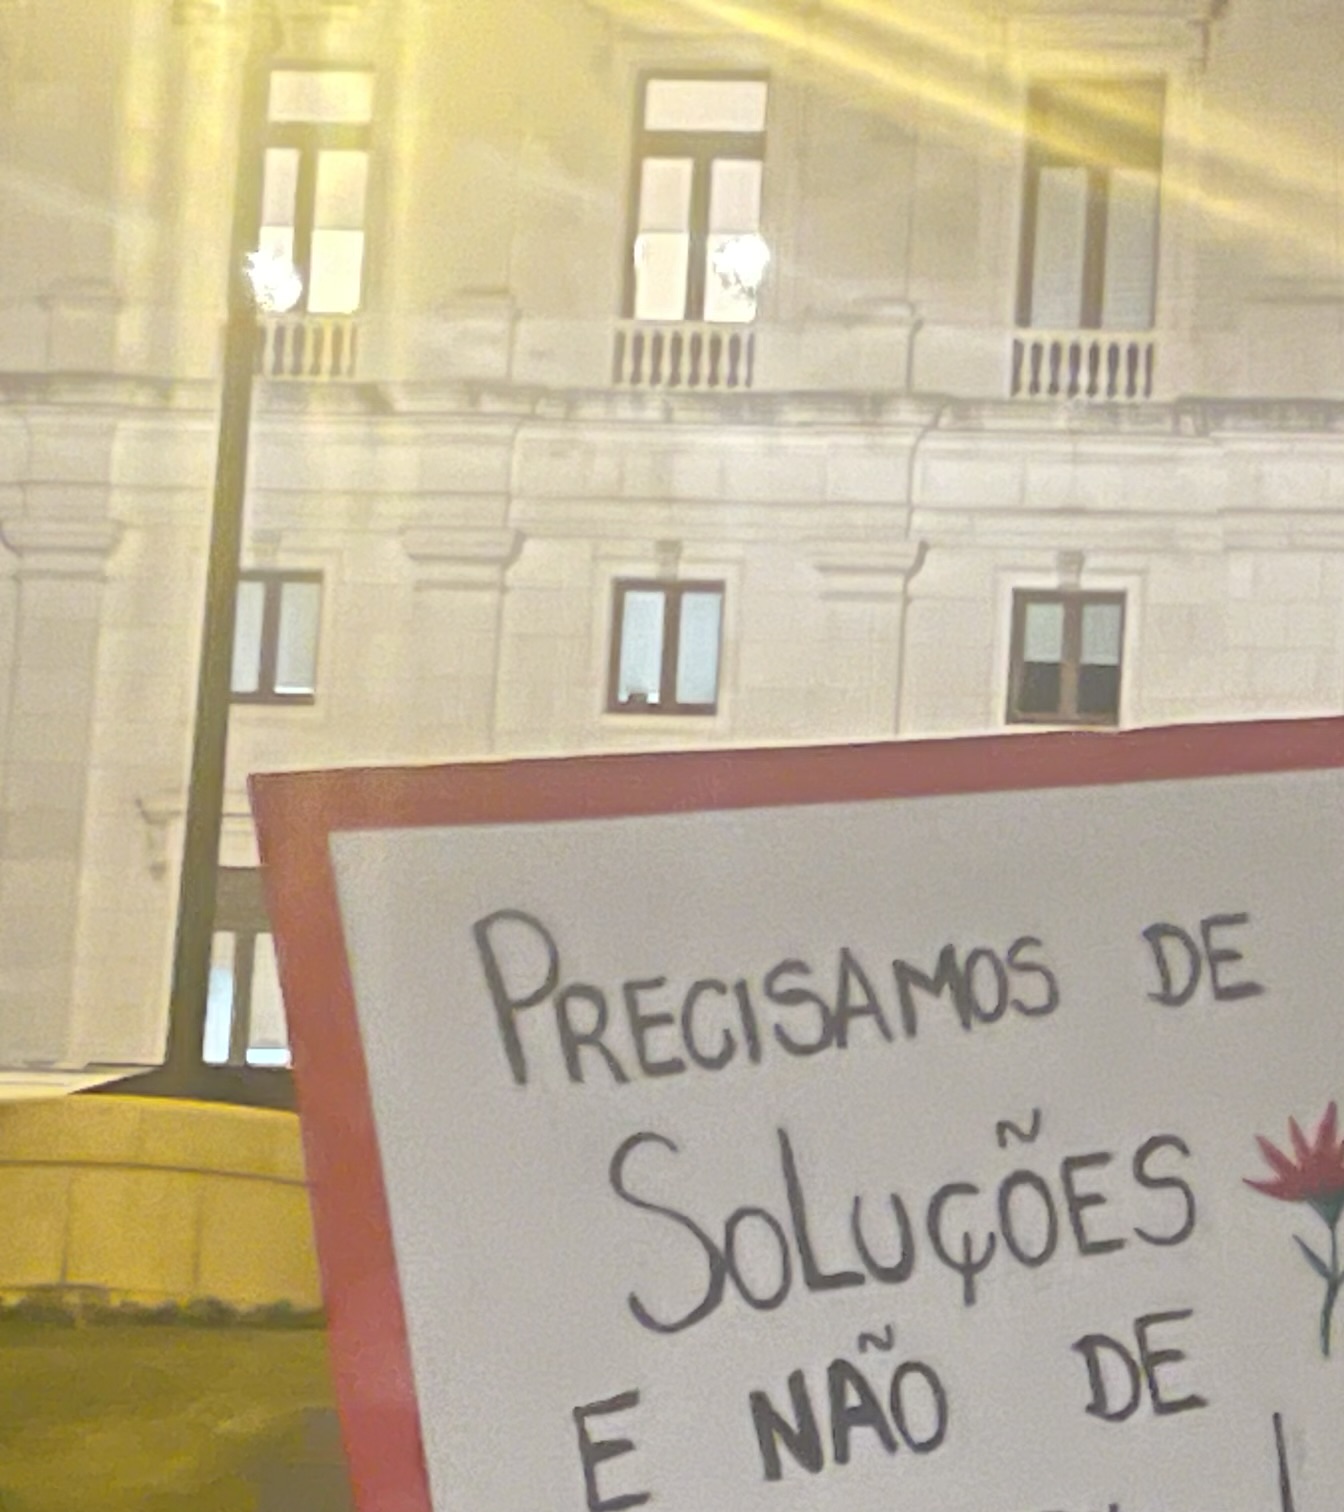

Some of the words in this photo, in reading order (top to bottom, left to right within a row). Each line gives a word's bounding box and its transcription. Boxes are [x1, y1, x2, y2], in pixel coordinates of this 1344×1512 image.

[473, 908, 1061, 1086] PRECISAMOS
[1142, 913, 1264, 1007] DE
[747, 1324, 951, 1483] NÃO
[1071, 1308, 1210, 1424] DE
